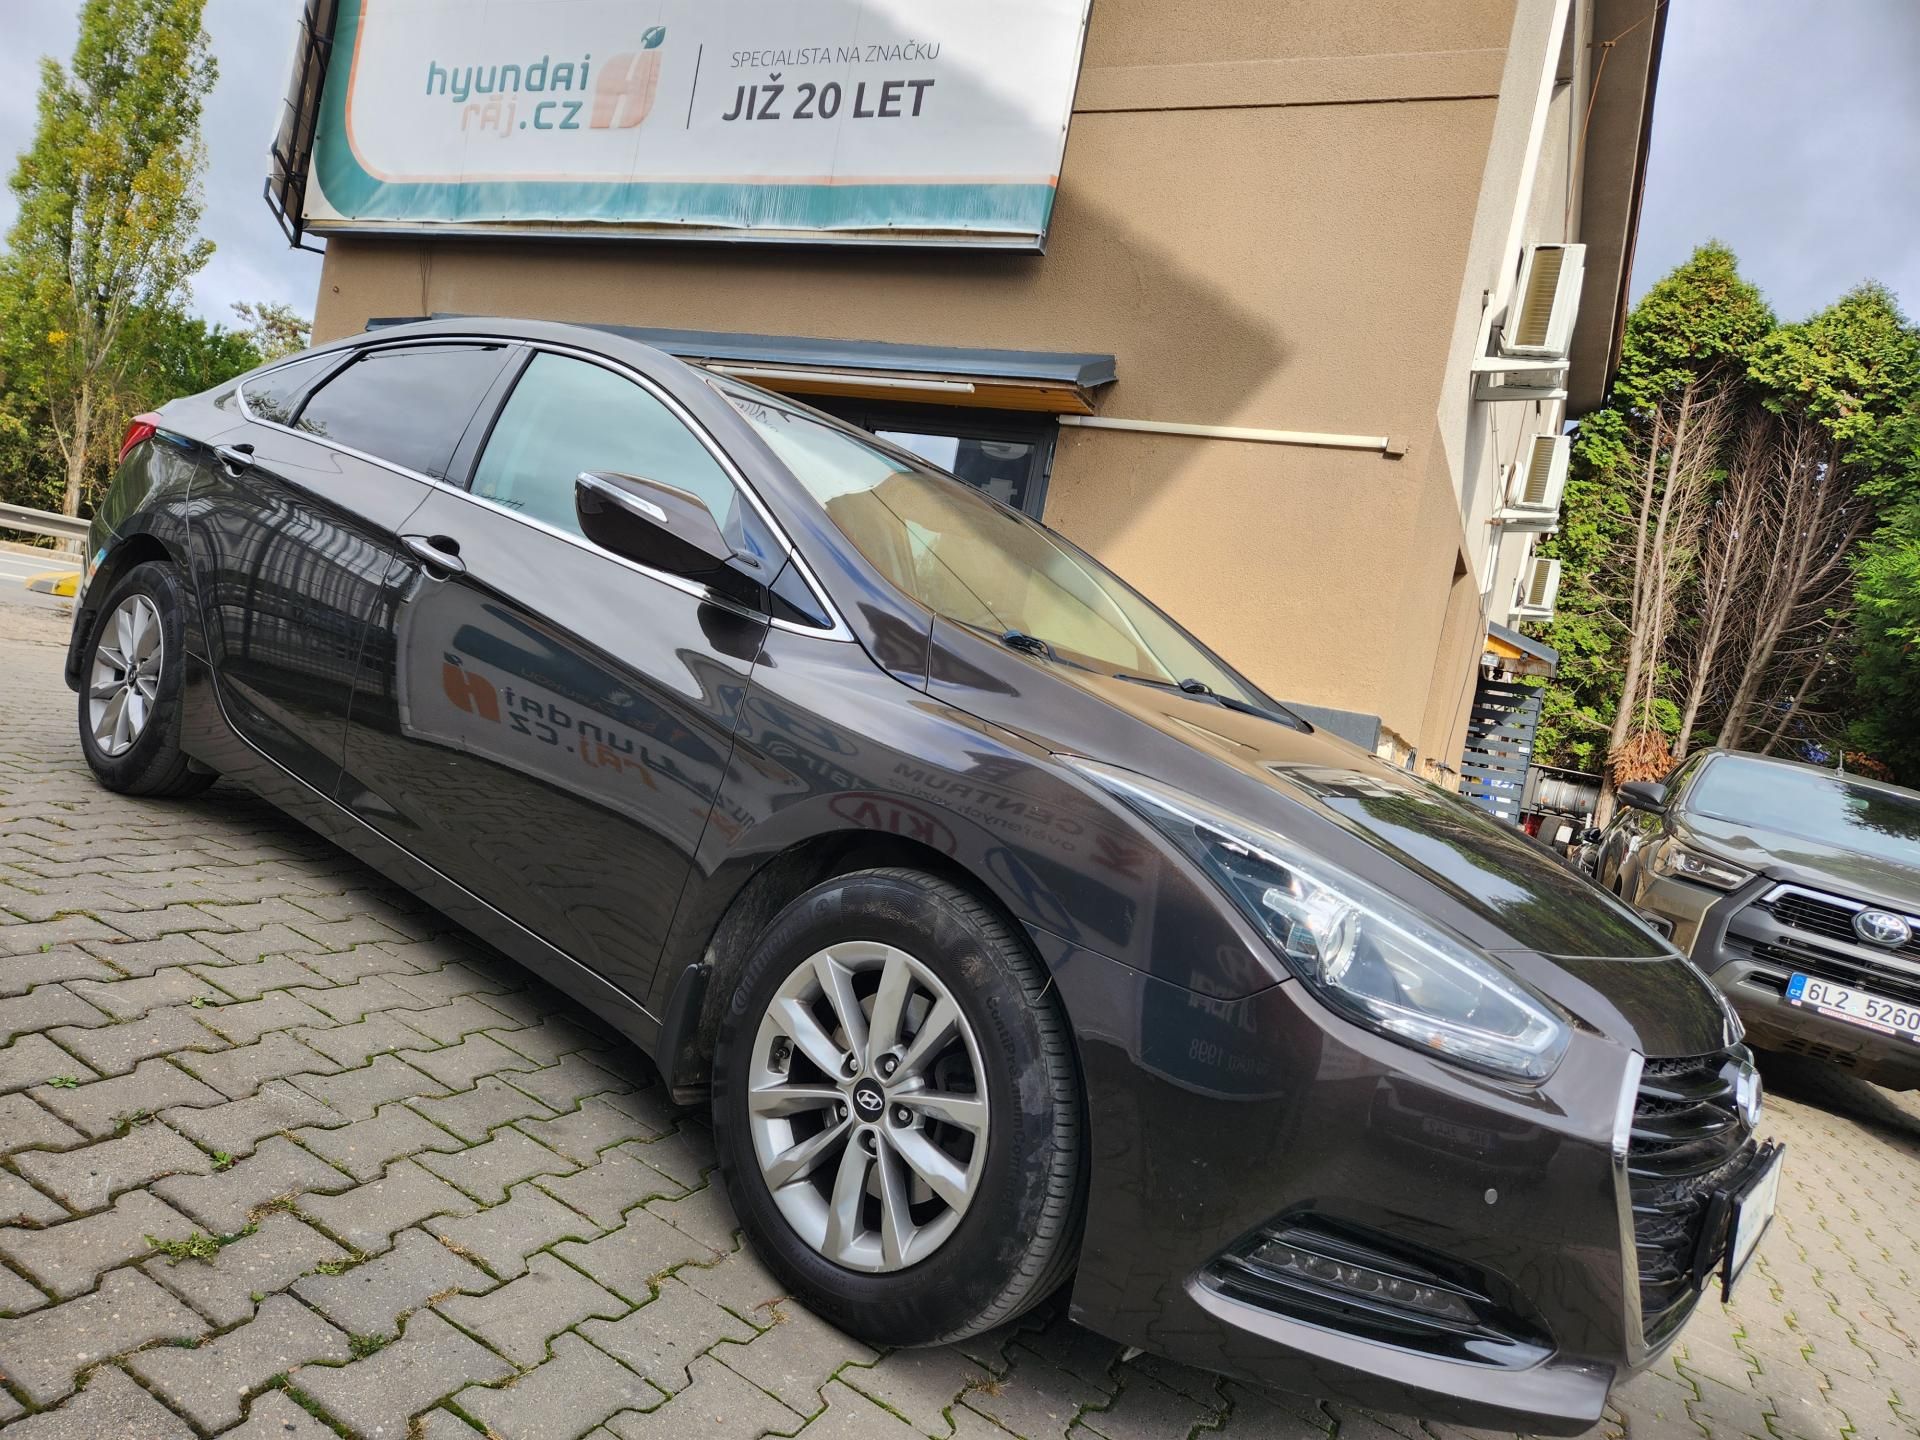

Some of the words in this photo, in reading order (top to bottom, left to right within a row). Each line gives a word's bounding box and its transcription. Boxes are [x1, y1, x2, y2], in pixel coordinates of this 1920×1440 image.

[730, 47, 831, 68] SPECIALISTA
[836, 46, 860, 63] NA
[865, 39, 941, 62] ZNAČKU
[721, 72, 785, 121] JIŽ
[792, 81, 842, 119] 20
[852, 79, 936, 118] LET
[1808, 983, 1849, 1010] 6L2
[1865, 999, 1920, 1030] 5260
